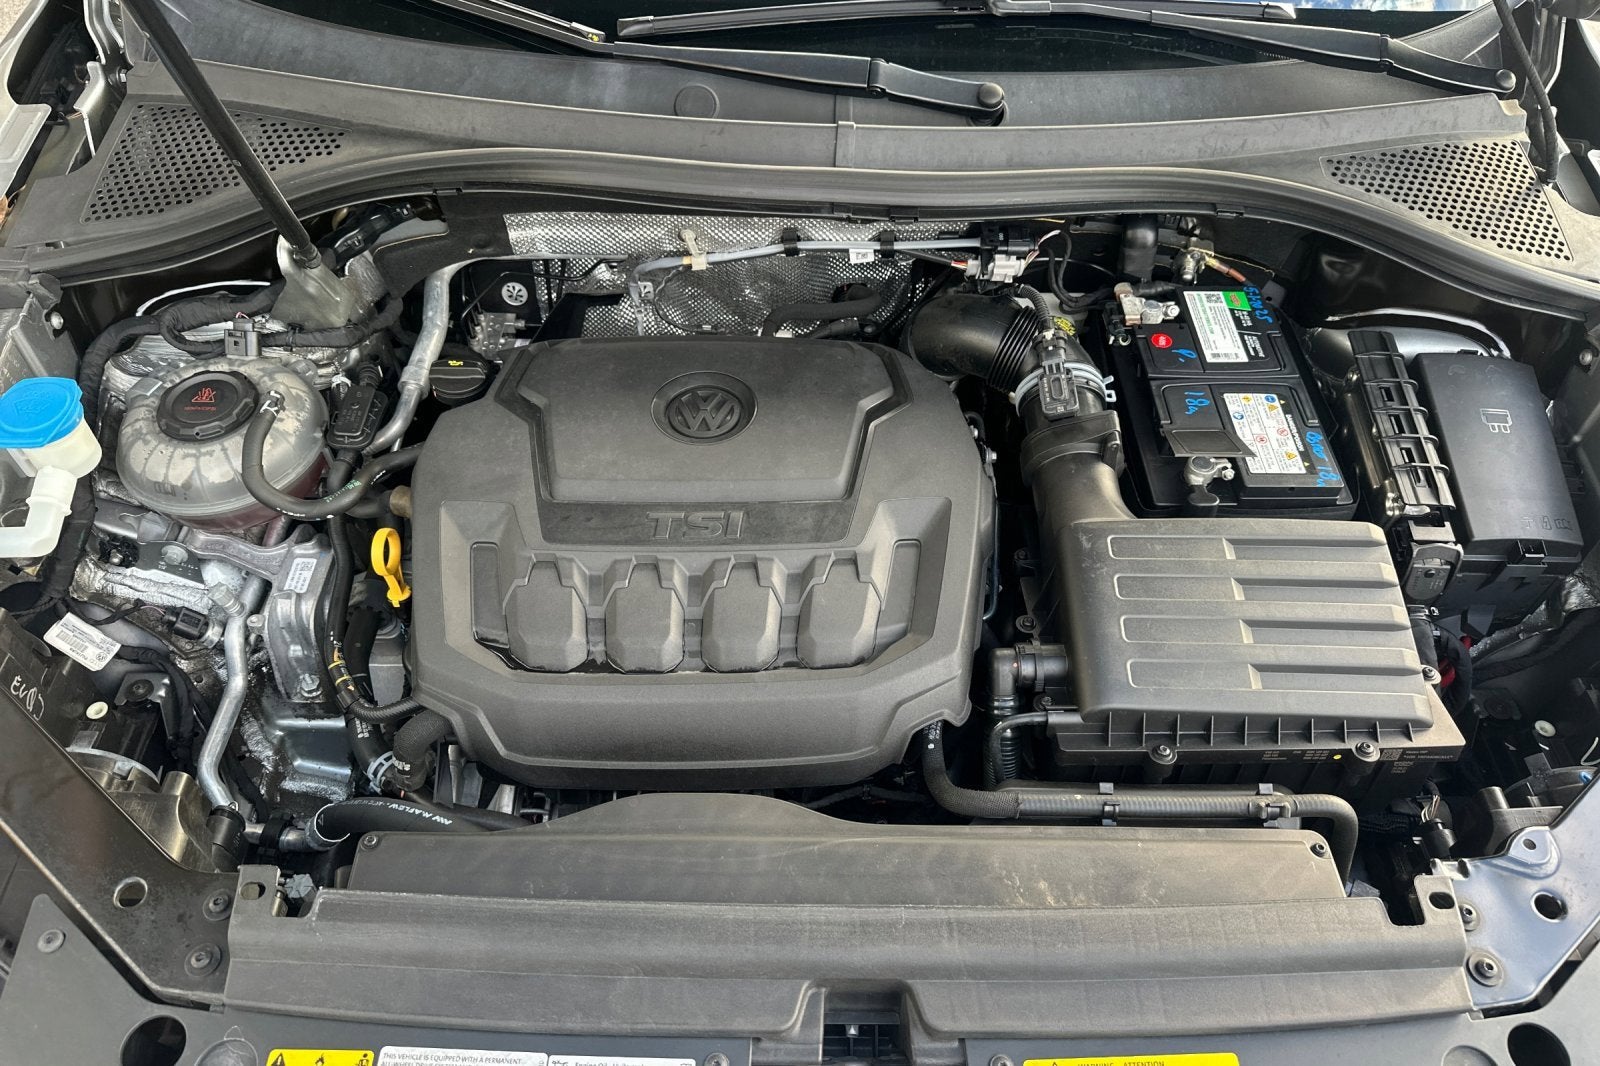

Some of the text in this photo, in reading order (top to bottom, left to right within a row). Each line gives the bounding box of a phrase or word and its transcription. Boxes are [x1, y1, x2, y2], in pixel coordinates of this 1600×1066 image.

[645, 510, 746, 541] TSI
[383, 1052, 397, 1060] THIS
[397, 1053, 423, 1061] VEHICLE
[430, 1054, 461, 1063] EQUIPPED
[461, 1055, 478, 1063] WITH
[484, 1057, 522, 1065] PERMANENT
